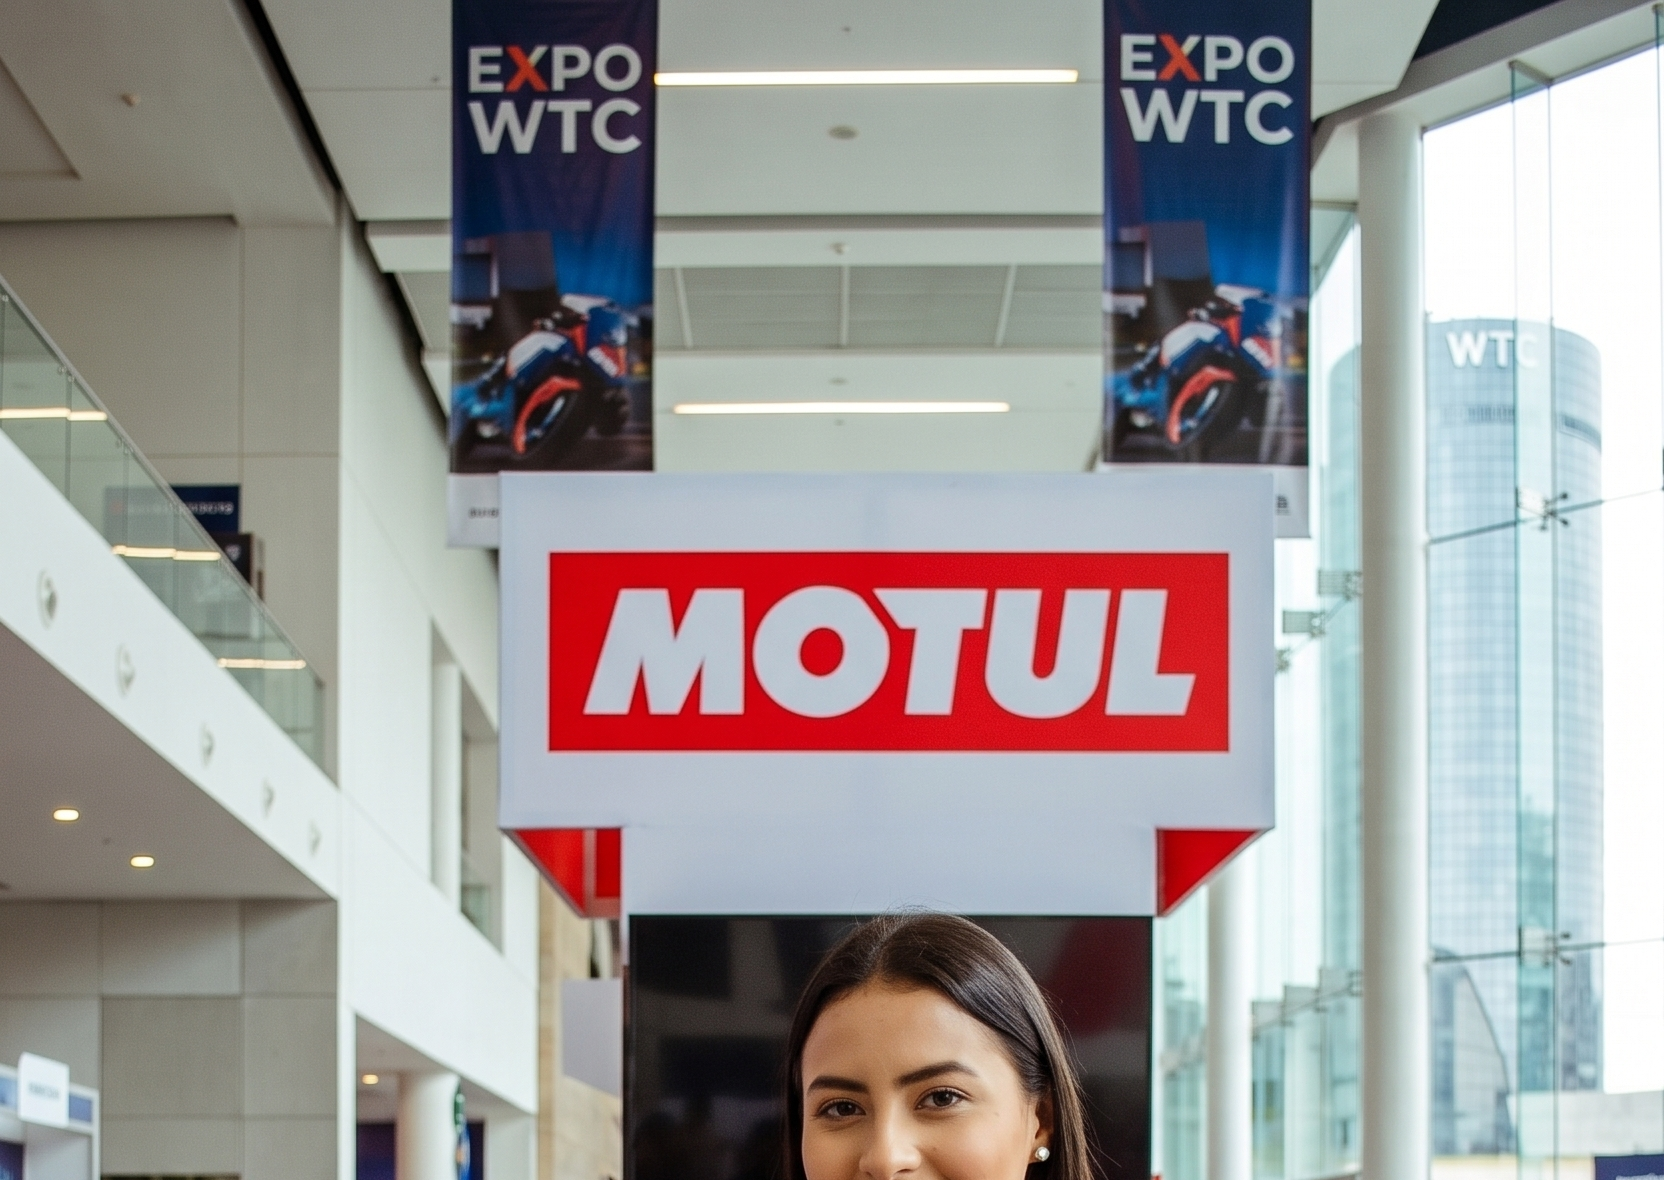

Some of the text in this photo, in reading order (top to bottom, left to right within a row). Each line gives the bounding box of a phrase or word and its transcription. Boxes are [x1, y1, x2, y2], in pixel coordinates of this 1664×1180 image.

[468, 43, 643, 93] EXPO
[1121, 33, 1295, 84] EXPO
[467, 98, 643, 154] WTC
[1120, 87, 1295, 145] WTC
[1446, 330, 1539, 369] WTC
[582, 585, 1196, 718] MOTUL
